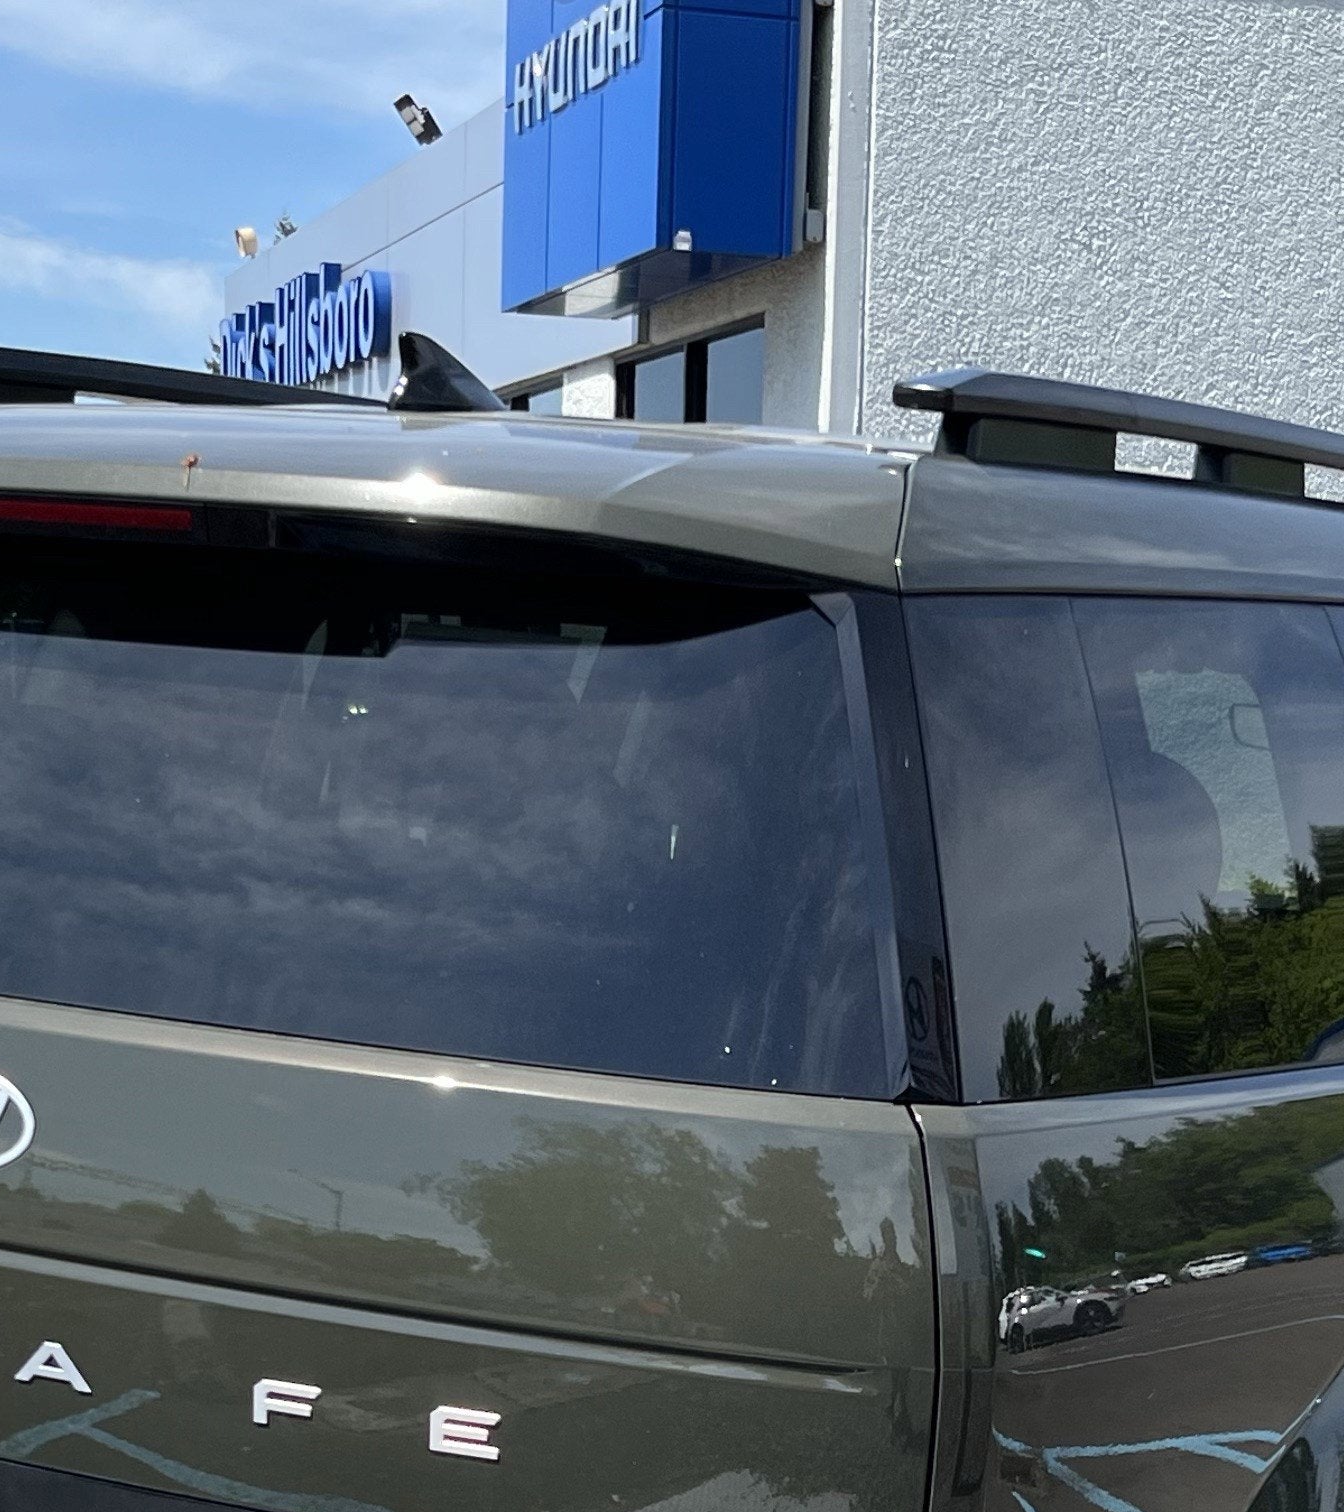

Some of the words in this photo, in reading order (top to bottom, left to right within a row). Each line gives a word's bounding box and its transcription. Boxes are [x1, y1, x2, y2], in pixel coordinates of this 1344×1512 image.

[514, 0, 639, 135] HYUNDAI
[219, 301, 274, 383] Dick's
[275, 262, 389, 386] Hillsboro
[252, 1378, 502, 1461] FE
